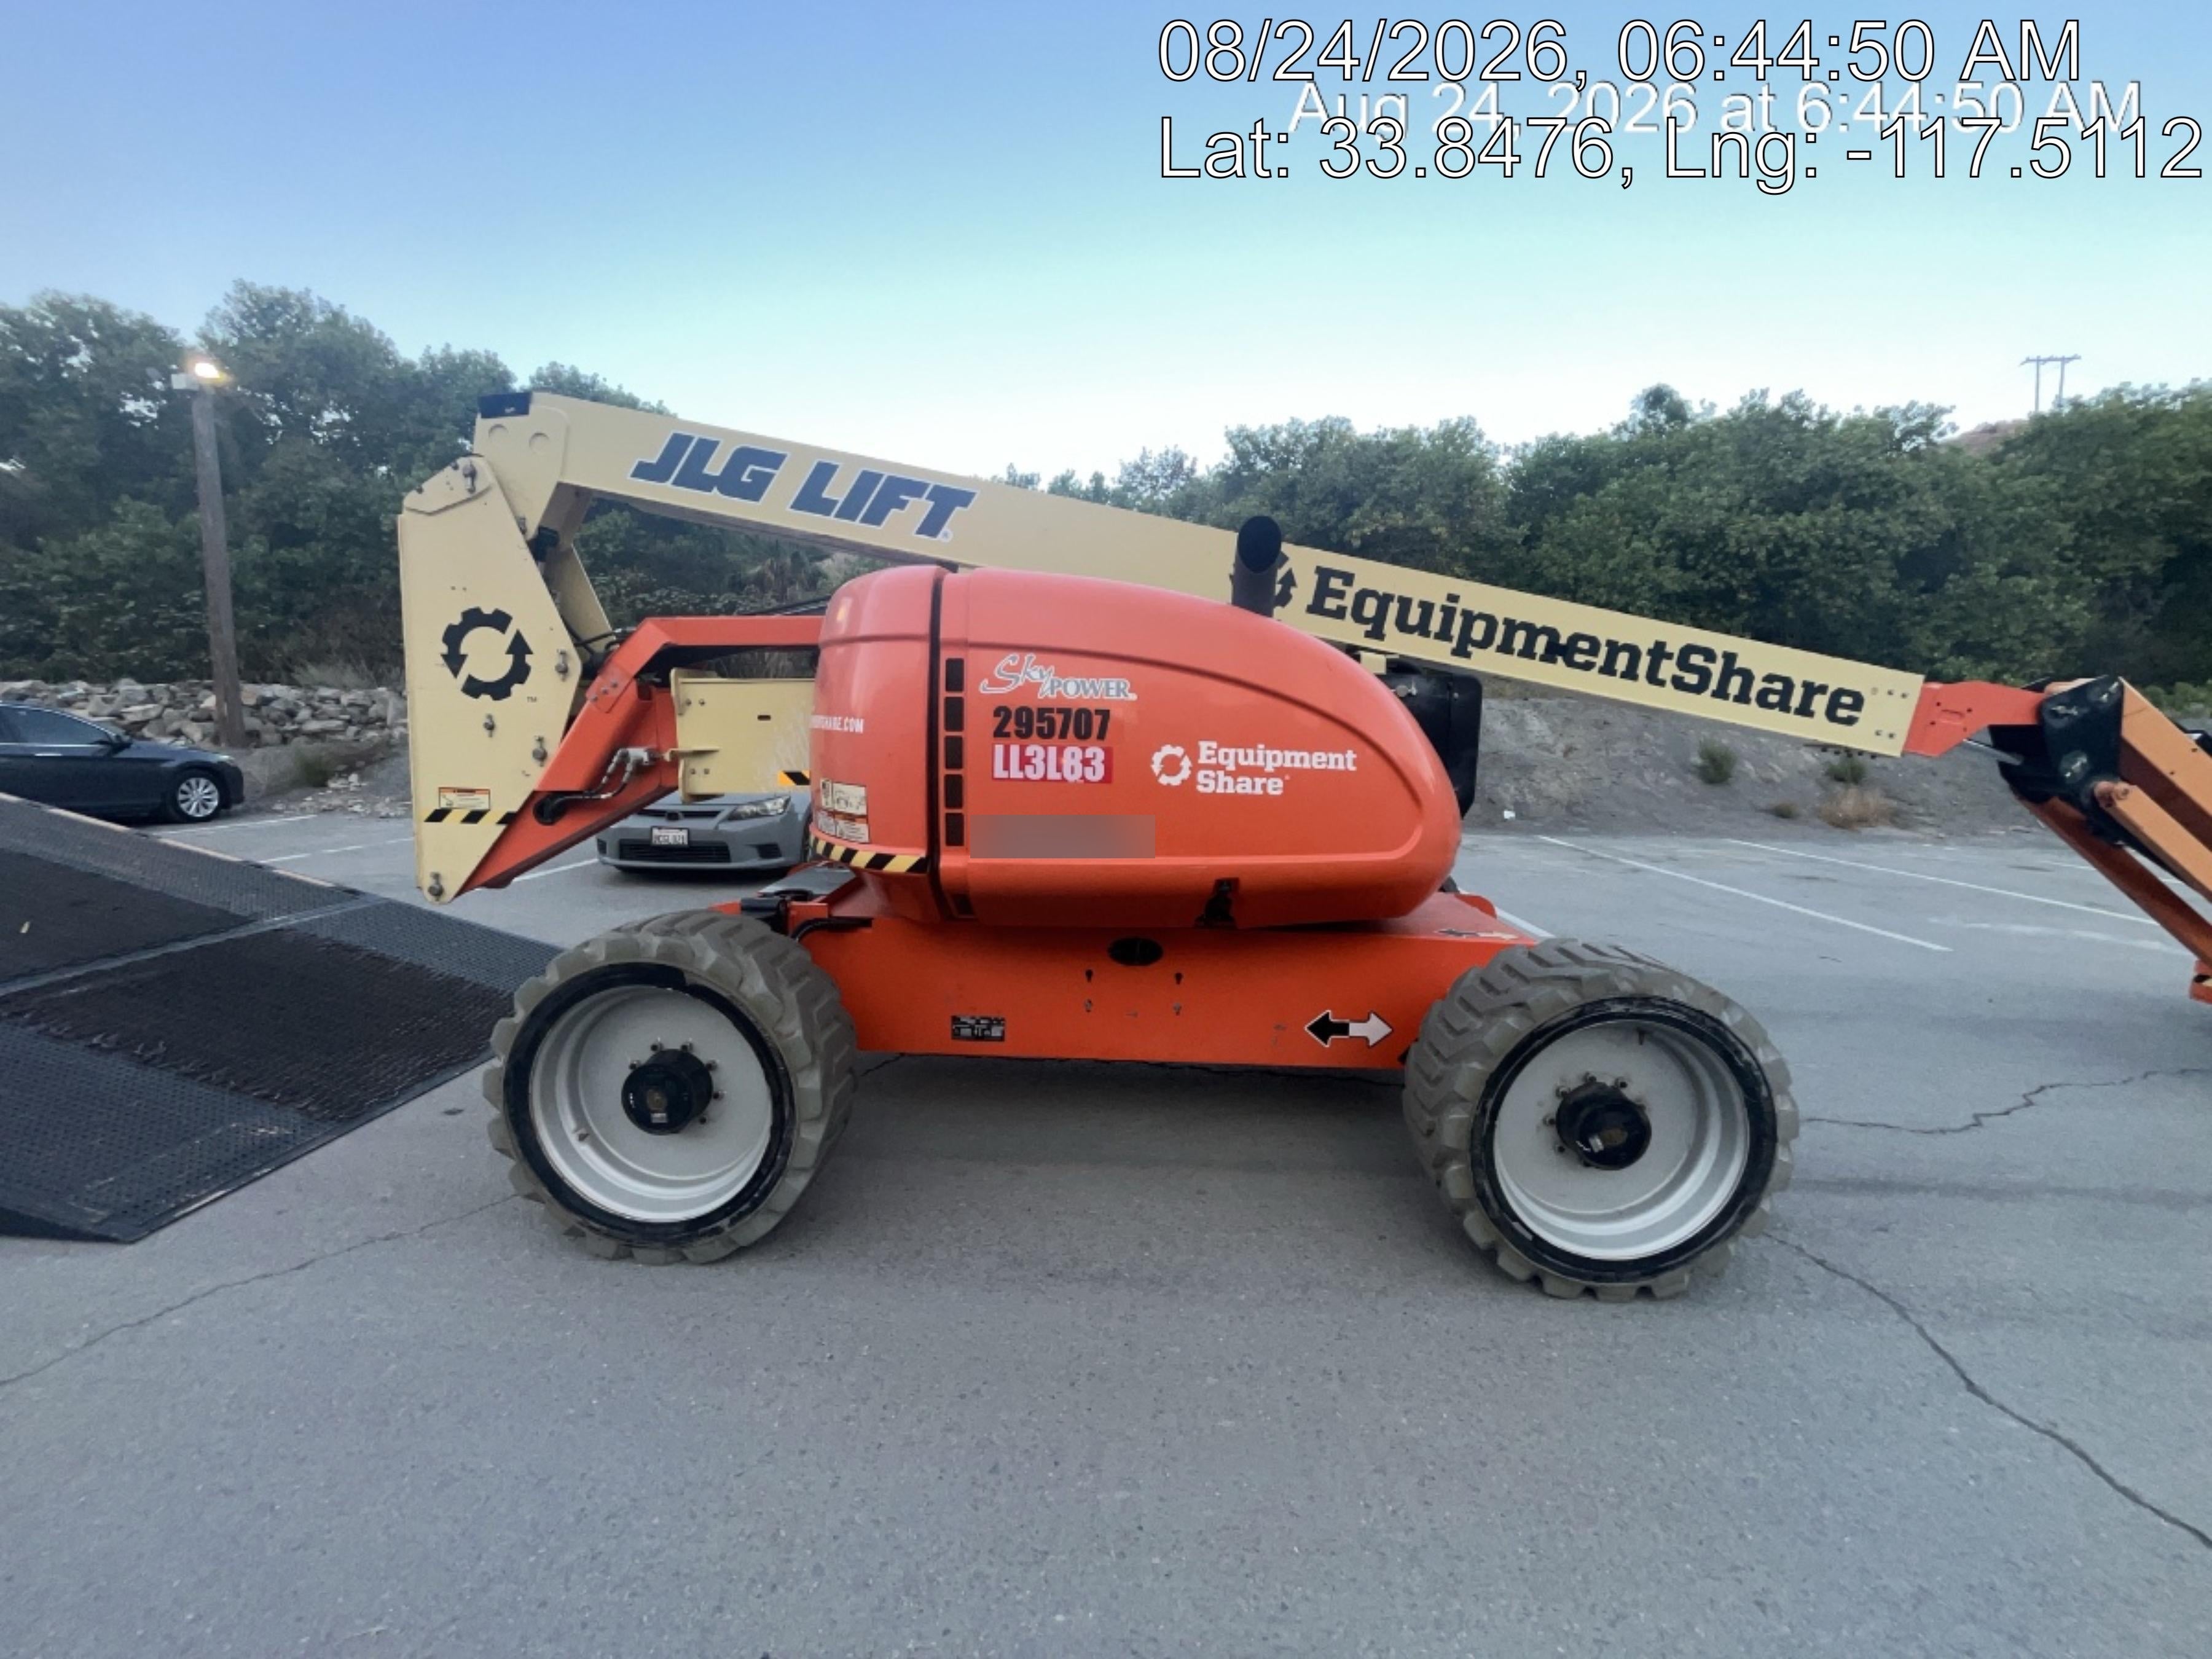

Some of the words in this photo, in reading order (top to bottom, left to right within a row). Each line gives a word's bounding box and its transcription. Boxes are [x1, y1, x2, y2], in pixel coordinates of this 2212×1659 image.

[627, 431, 790, 504] JLG
[787, 459, 981, 539] LIFT
[1306, 565, 1865, 727] EquipmentShare
[979, 653, 1054, 699] Sky
[1048, 678, 1131, 699] POWER
[993, 705, 1111, 741] 295707
[1198, 740, 1357, 771] Equipment
[1196, 769, 1284, 795] Share
